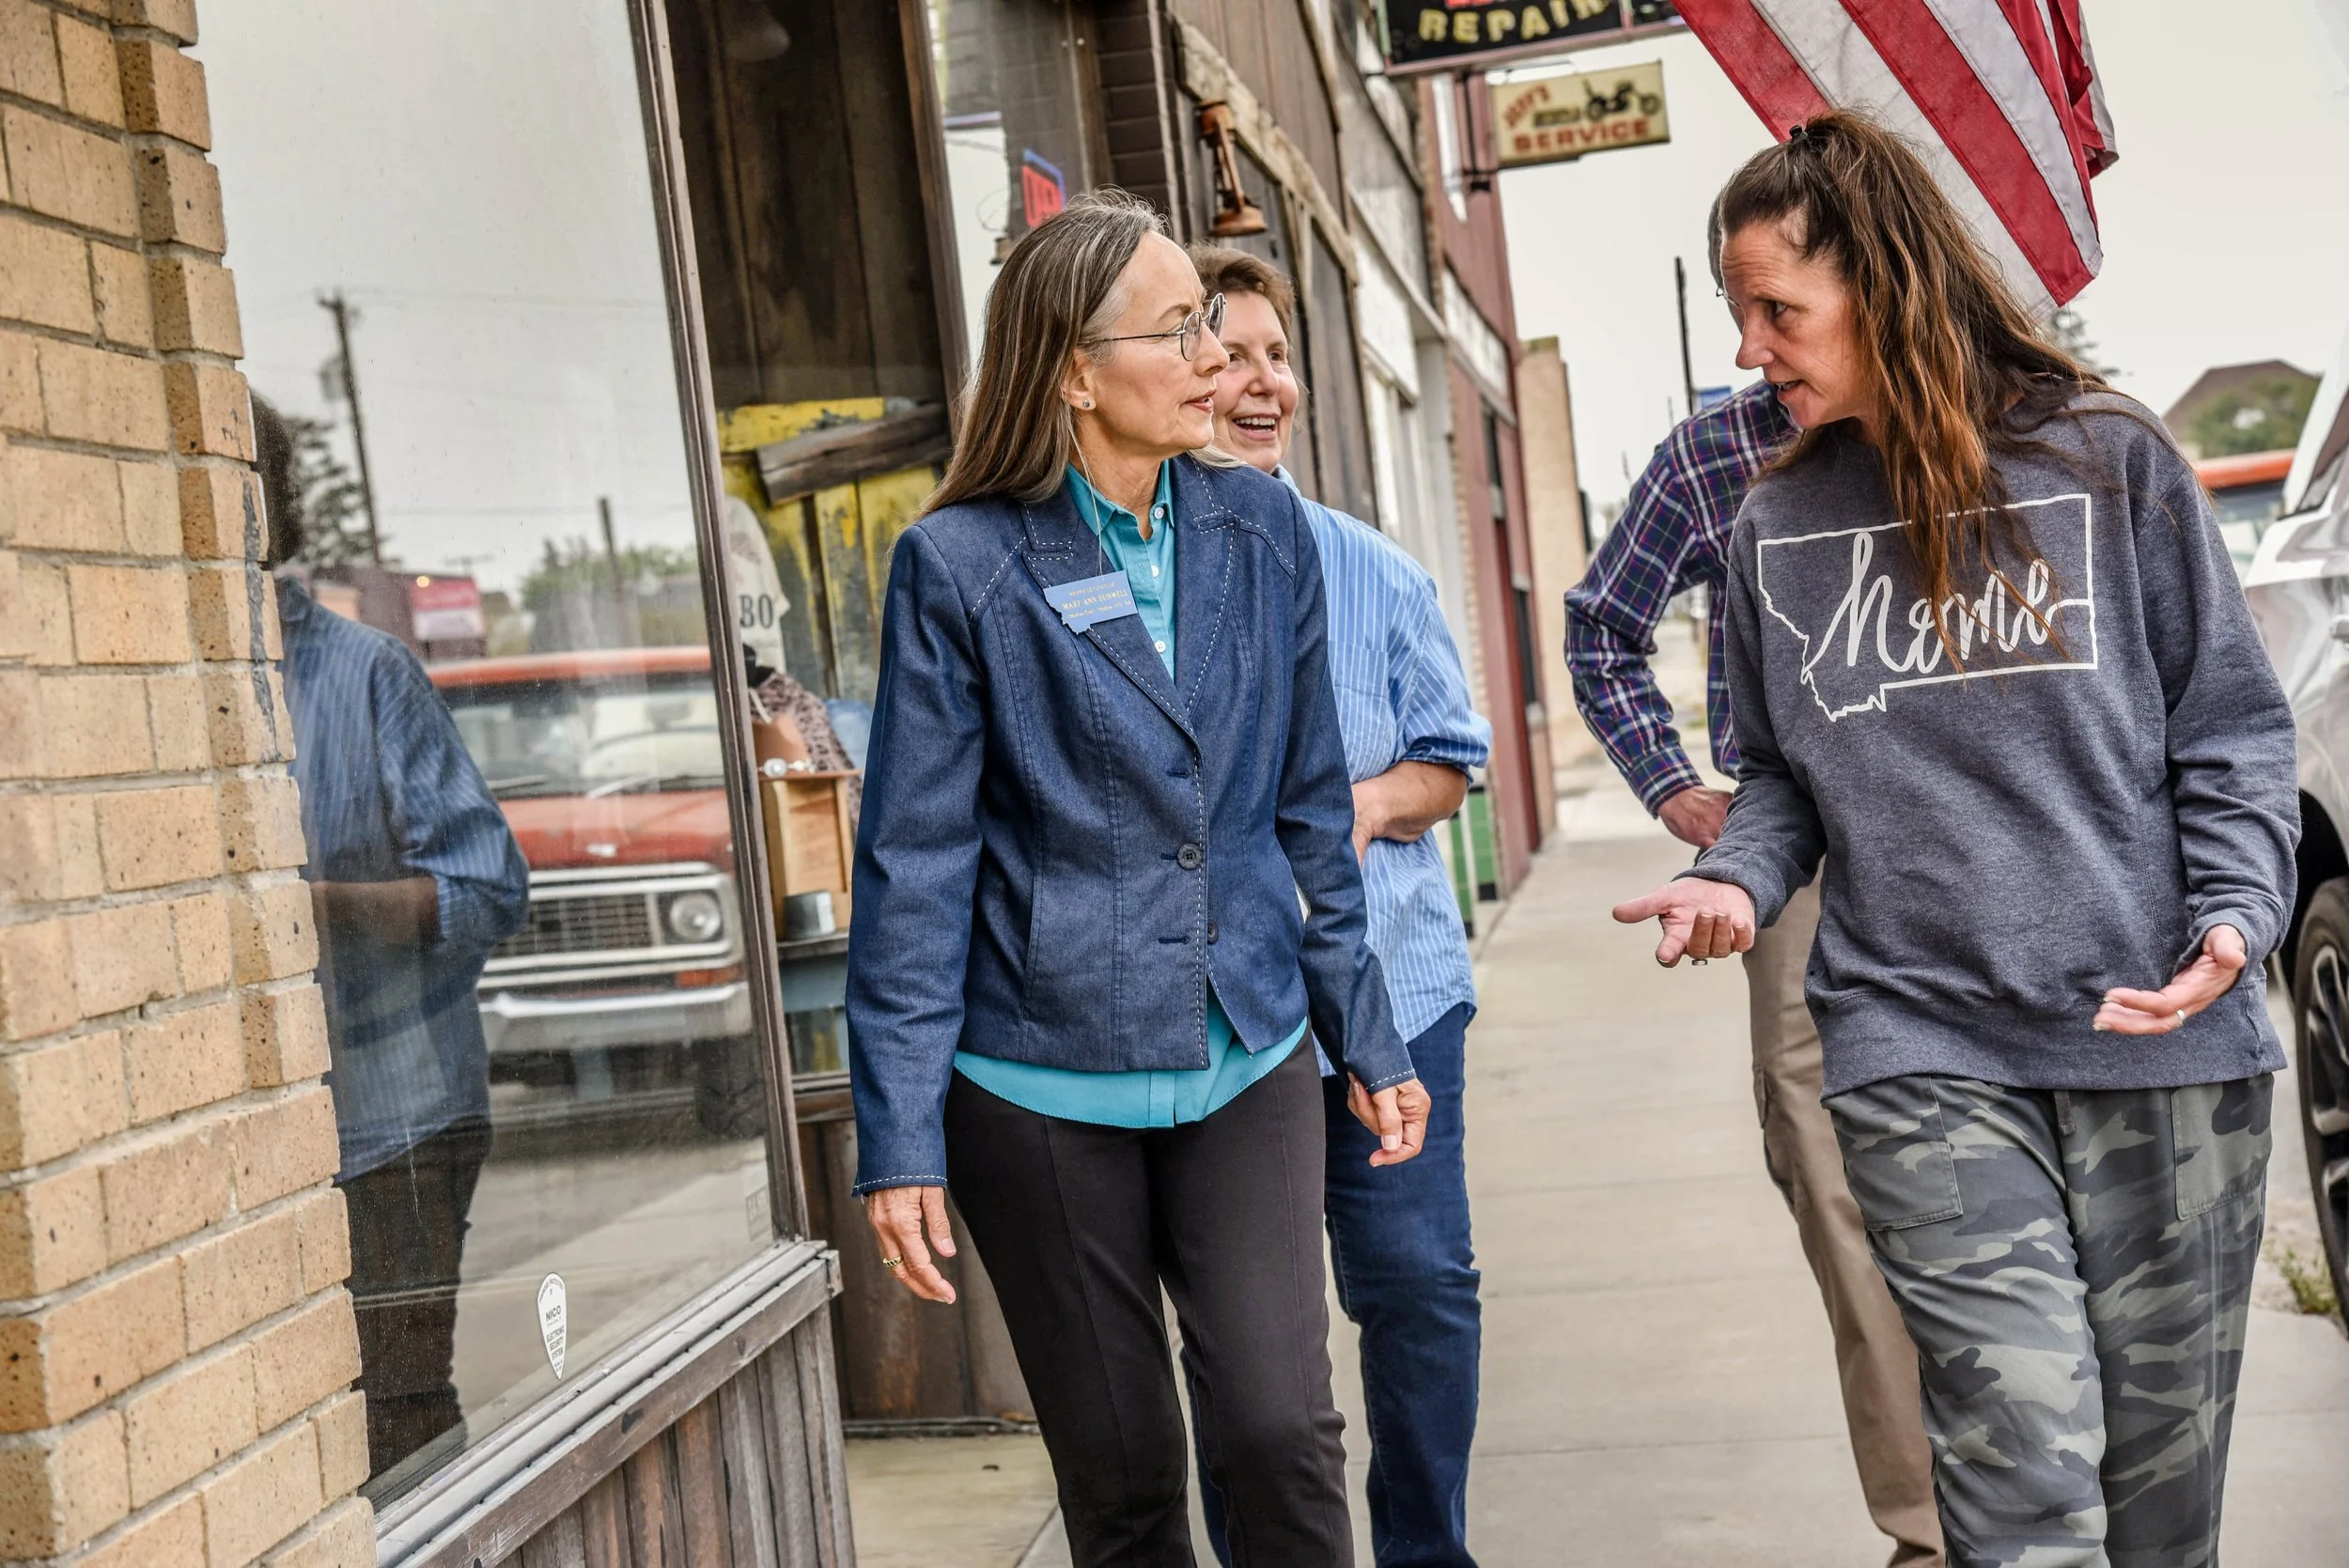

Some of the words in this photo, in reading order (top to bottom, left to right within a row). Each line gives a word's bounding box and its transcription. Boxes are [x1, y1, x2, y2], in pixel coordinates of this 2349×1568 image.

[1515, 117, 1651, 153] SERVICE
[1801, 532, 2081, 684] home
[546, 1304, 562, 1322] NICO
